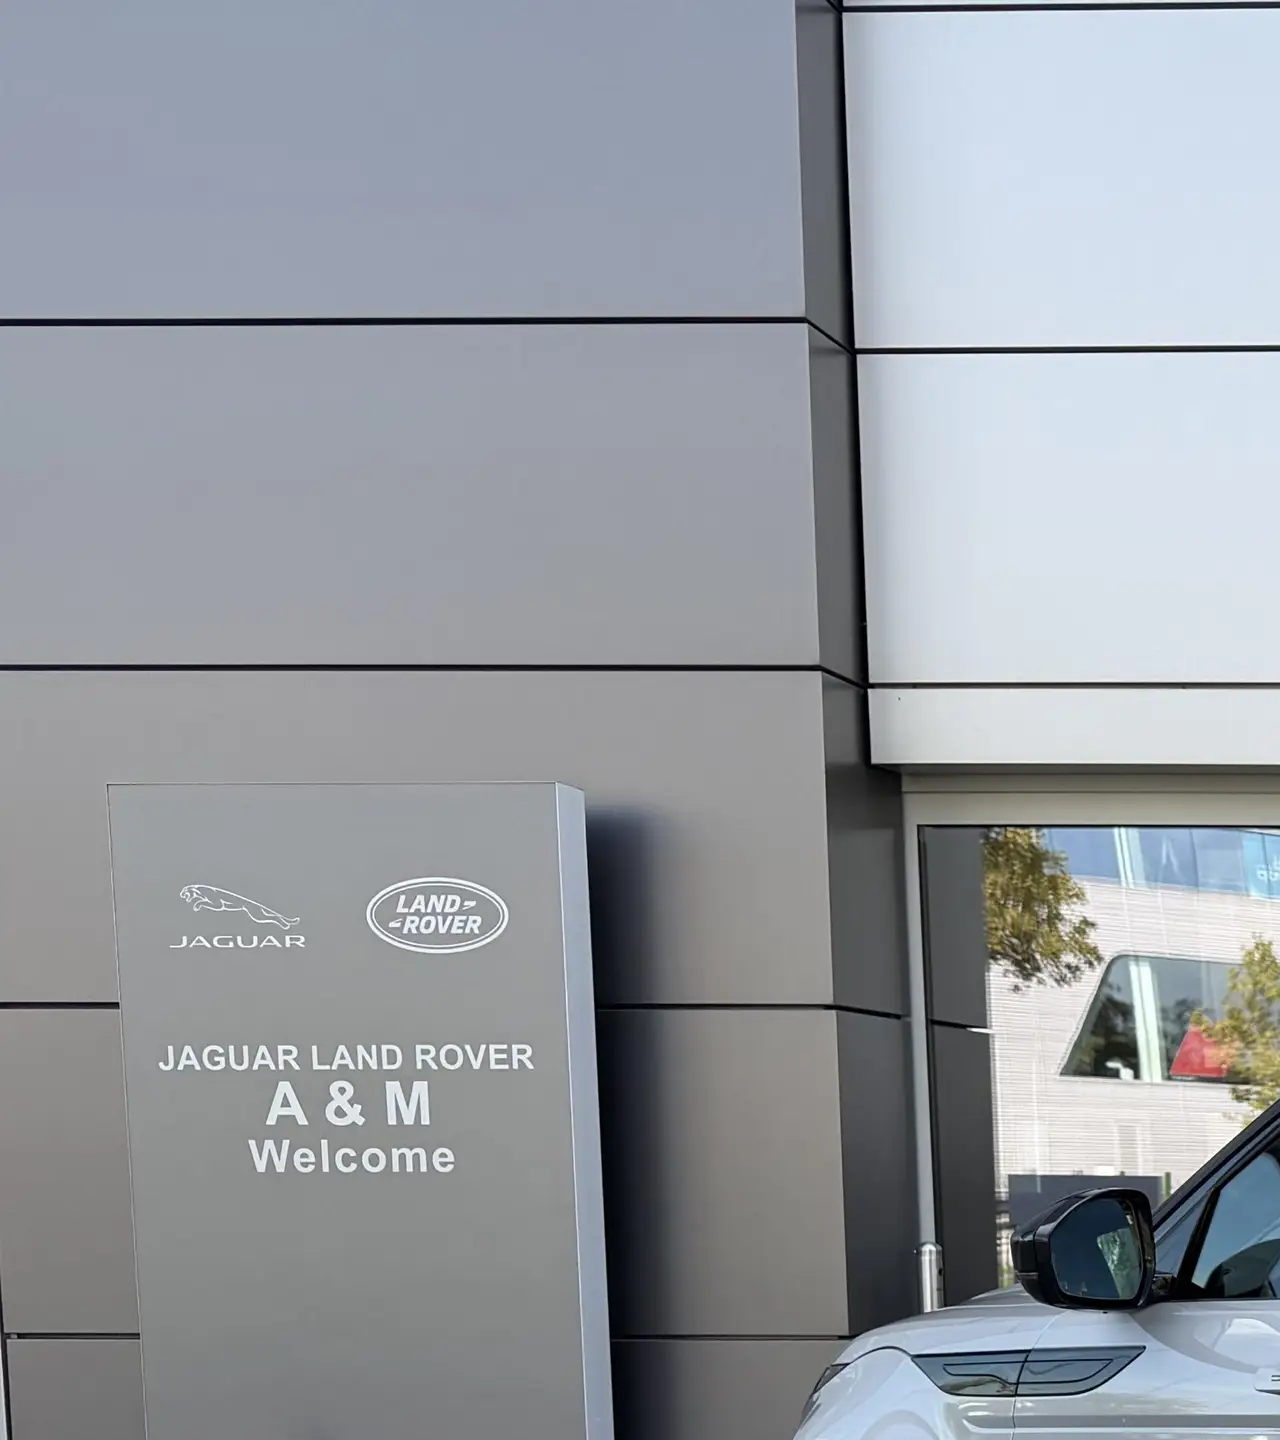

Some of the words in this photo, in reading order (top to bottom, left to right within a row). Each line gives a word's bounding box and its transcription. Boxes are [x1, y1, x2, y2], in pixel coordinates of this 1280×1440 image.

[395, 894, 461, 913] LAND
[402, 915, 483, 935] ROVER
[169, 934, 306, 948] JAGUAR
[158, 1045, 300, 1071] JAGUAR
[311, 1045, 403, 1070] LAND
[415, 1044, 534, 1070] ROVER
[266, 1081, 309, 1125] A
[325, 1080, 366, 1126] &
[385, 1081, 431, 1125] M
[248, 1138, 456, 1173] Welcome
